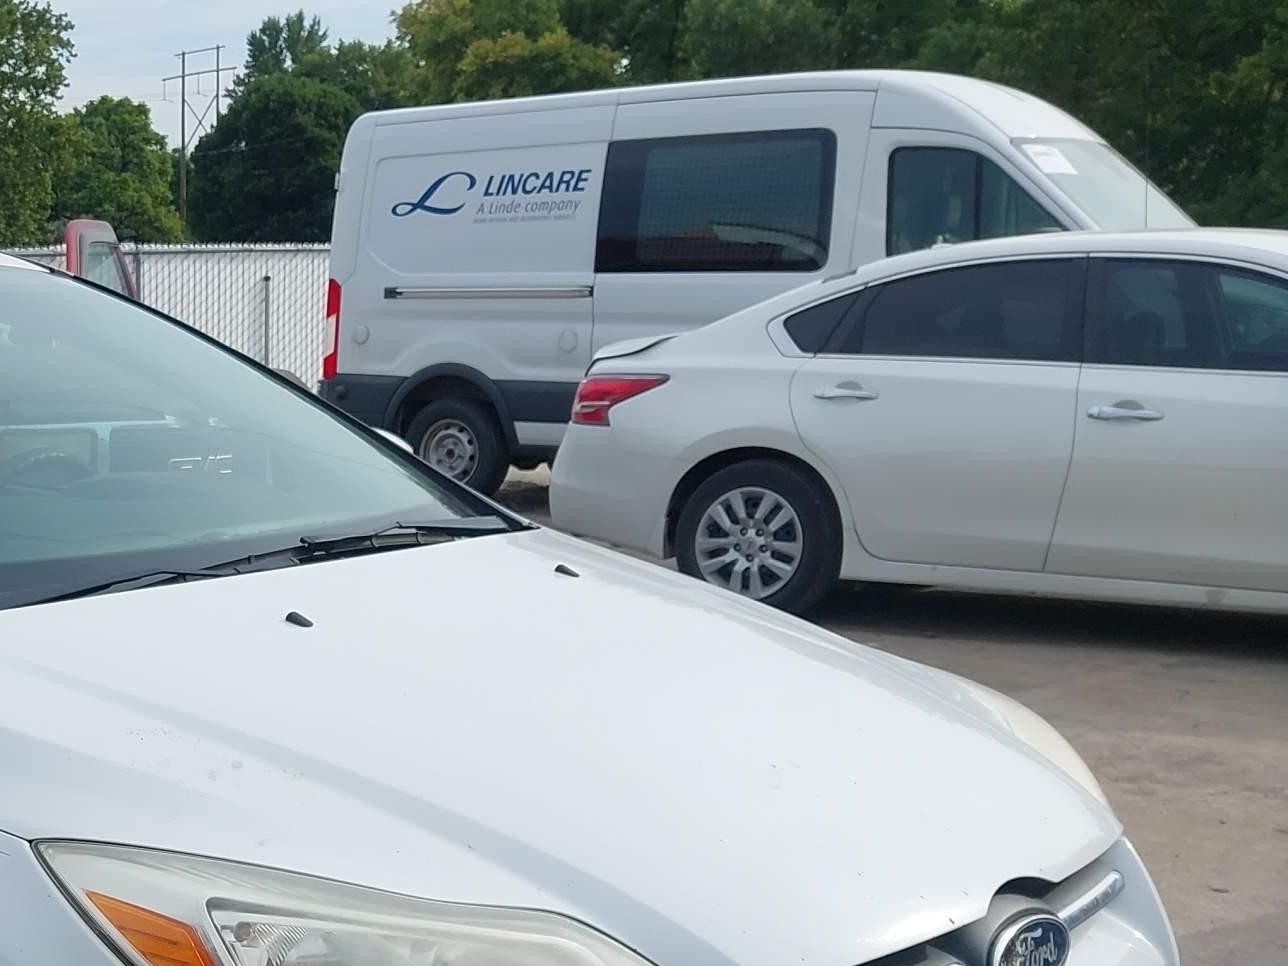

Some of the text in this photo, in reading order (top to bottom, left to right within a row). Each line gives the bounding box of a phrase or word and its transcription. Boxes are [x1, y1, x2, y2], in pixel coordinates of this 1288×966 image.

[483, 169, 592, 197] LINCARE
[476, 199, 582, 216] A Linde company
